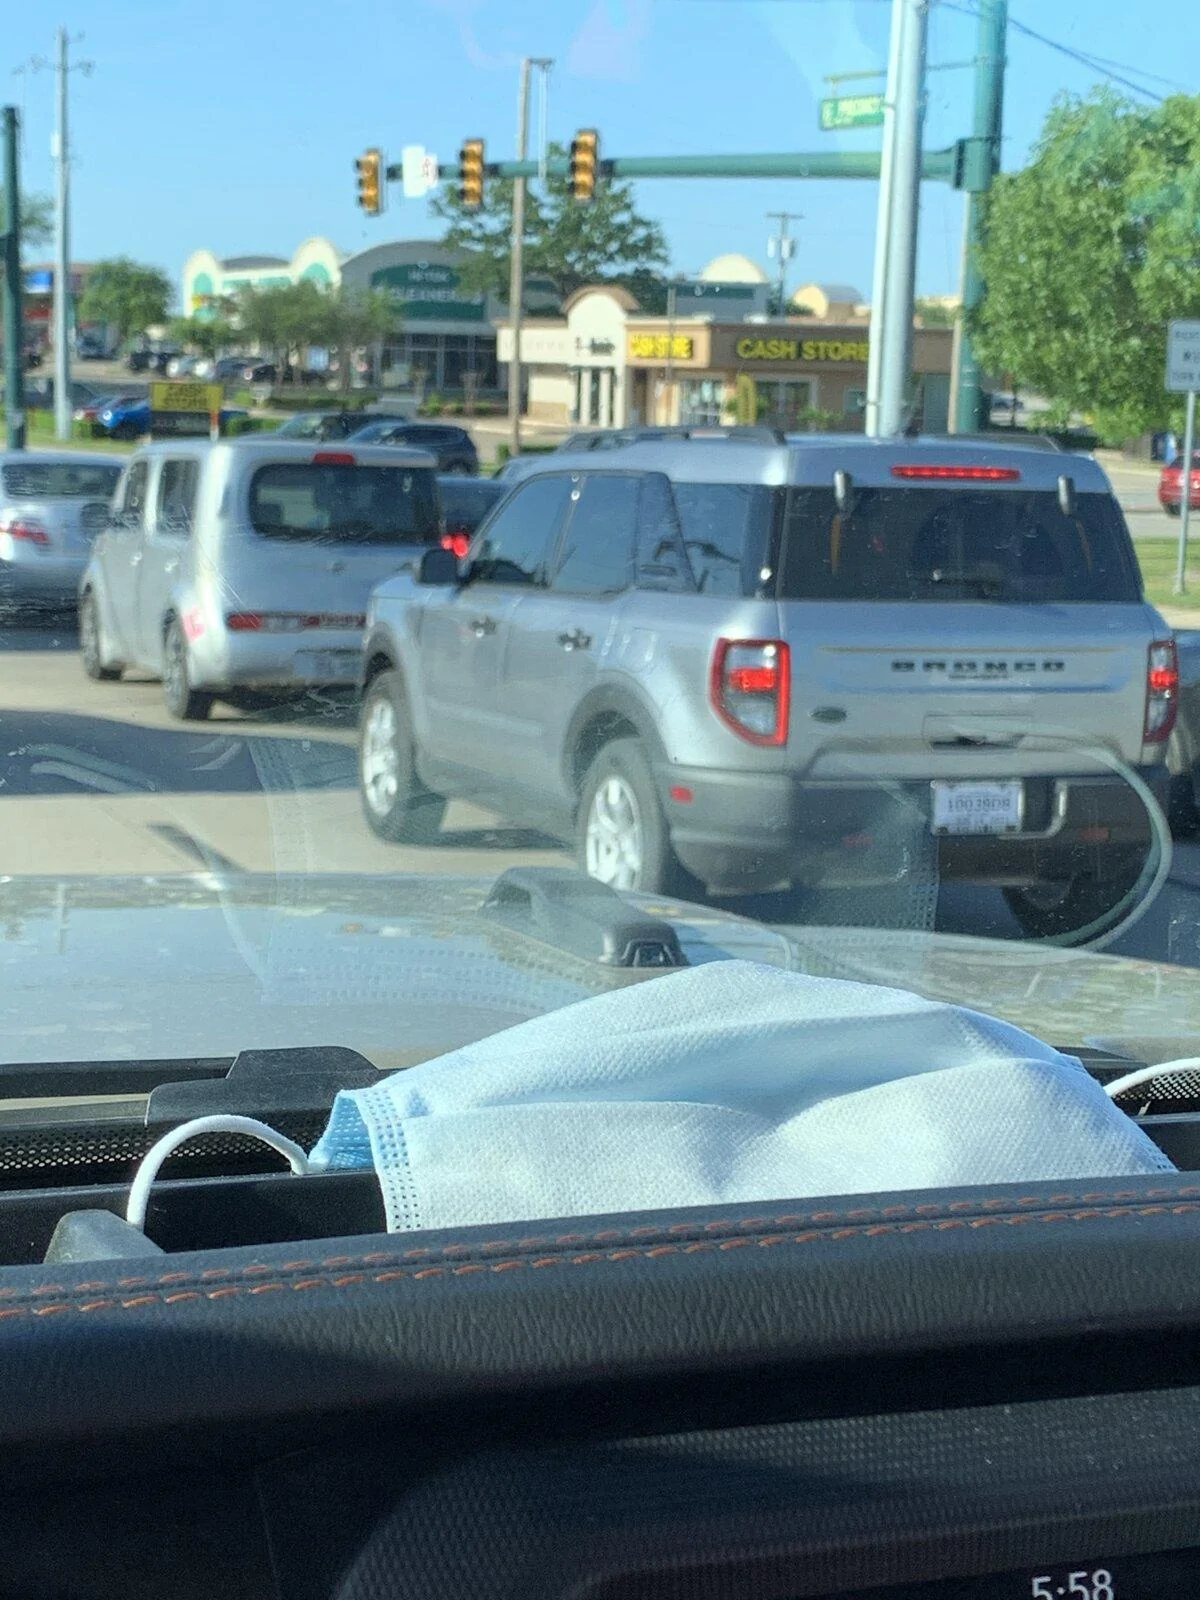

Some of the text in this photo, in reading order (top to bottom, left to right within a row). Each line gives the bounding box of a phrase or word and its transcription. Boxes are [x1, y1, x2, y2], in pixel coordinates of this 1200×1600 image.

[737, 338, 869, 362] CASH STORE
[891, 661, 1065, 673] BRONCO
[1031, 1568, 1114, 1600] 5:58
